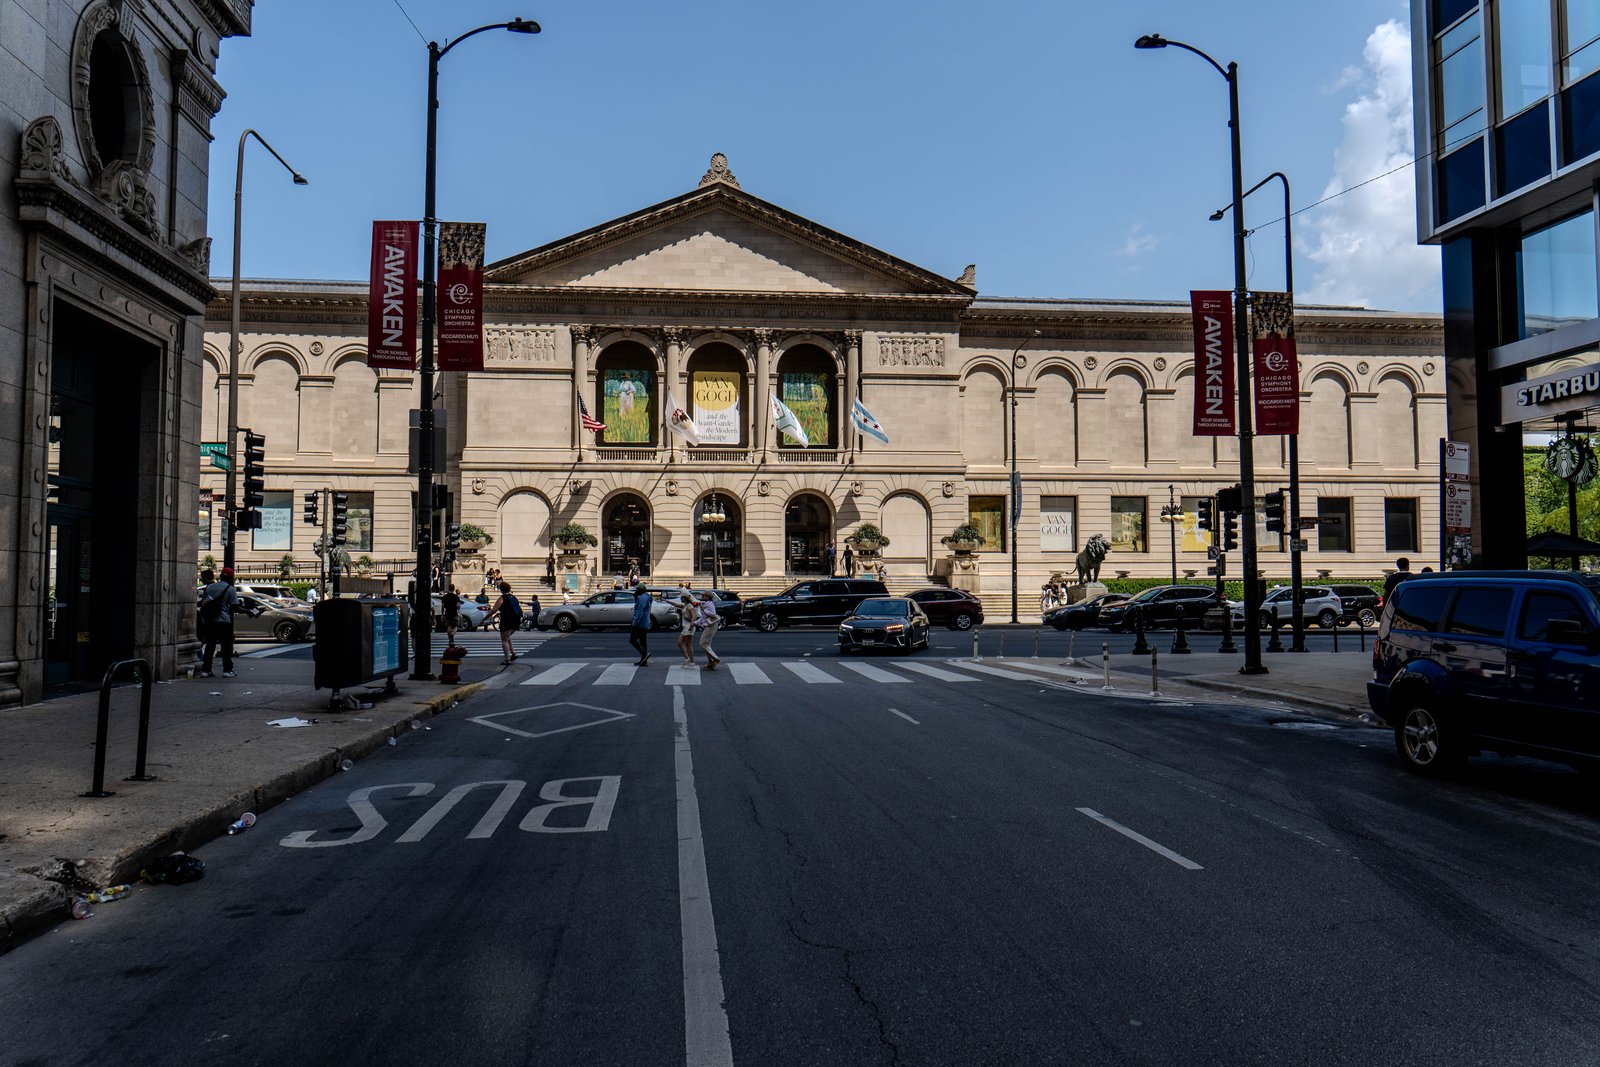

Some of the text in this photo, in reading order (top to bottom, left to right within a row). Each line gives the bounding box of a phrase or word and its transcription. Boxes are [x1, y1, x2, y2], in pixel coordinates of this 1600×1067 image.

[382, 245, 405, 348] AWAKEN
[484, 304, 560, 313] ANNO DOMINI
[612, 306, 634, 315] THE
[648, 306, 670, 316] ART
[752, 309, 768, 318] OF
[780, 309, 826, 319] CHICAGO
[1203, 316, 1223, 415] AWAKEN
[703, 376, 730, 389] VAN
[1517, 371, 1600, 406] STARBU
[696, 390, 738, 402] GOGH
[1047, 515, 1066, 524] VAN
[1041, 525, 1073, 535] GOGH
[279, 775, 622, 848] BUS
